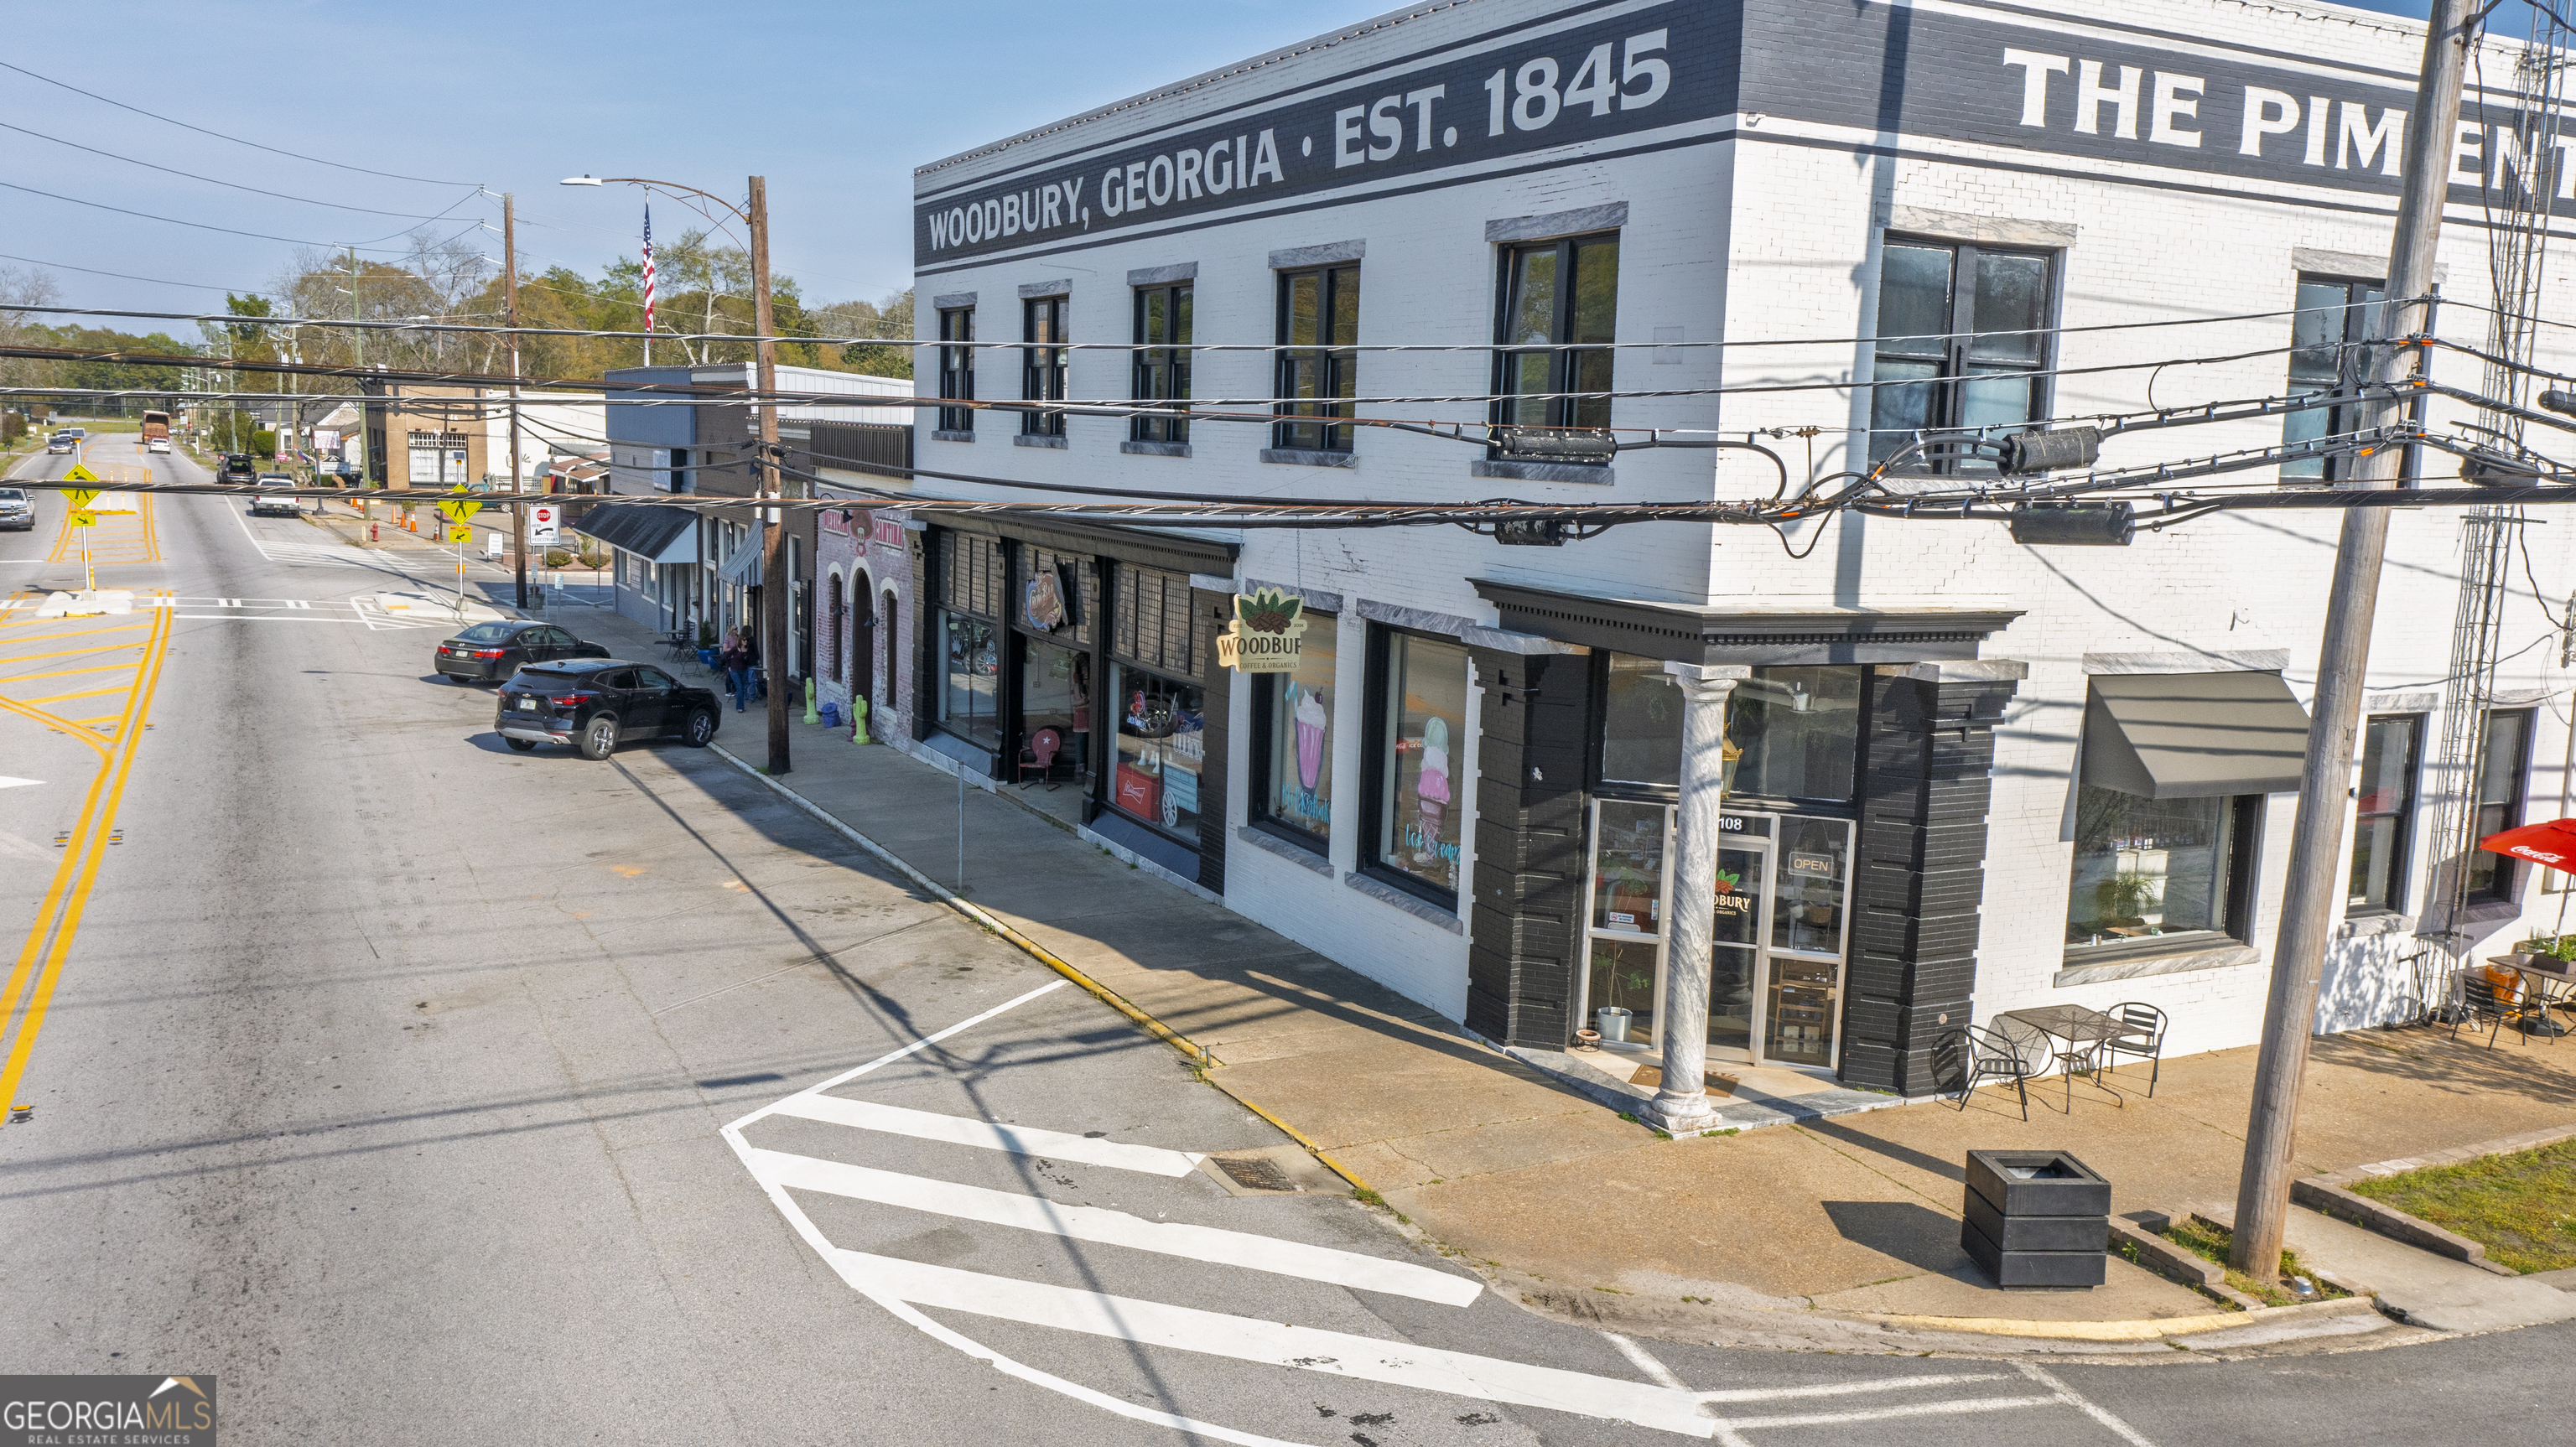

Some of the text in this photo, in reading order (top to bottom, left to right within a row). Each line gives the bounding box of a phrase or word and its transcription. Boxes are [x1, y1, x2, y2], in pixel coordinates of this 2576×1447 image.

[2003, 48, 2576, 200] THE PIMENT
[928, 28, 1670, 251] WOODBURY, GEORGIA EST. 1845
[875, 520, 902, 547] CANTINA
[1221, 637, 1301, 656] WOODBUR
[1173, 732, 1203, 762] ULTR
[1405, 823, 1424, 848] Ice
[1718, 817, 1742, 830] 108
[1794, 858, 1829, 872] OPEN
[2510, 846, 2566, 864] Coca-Cola
